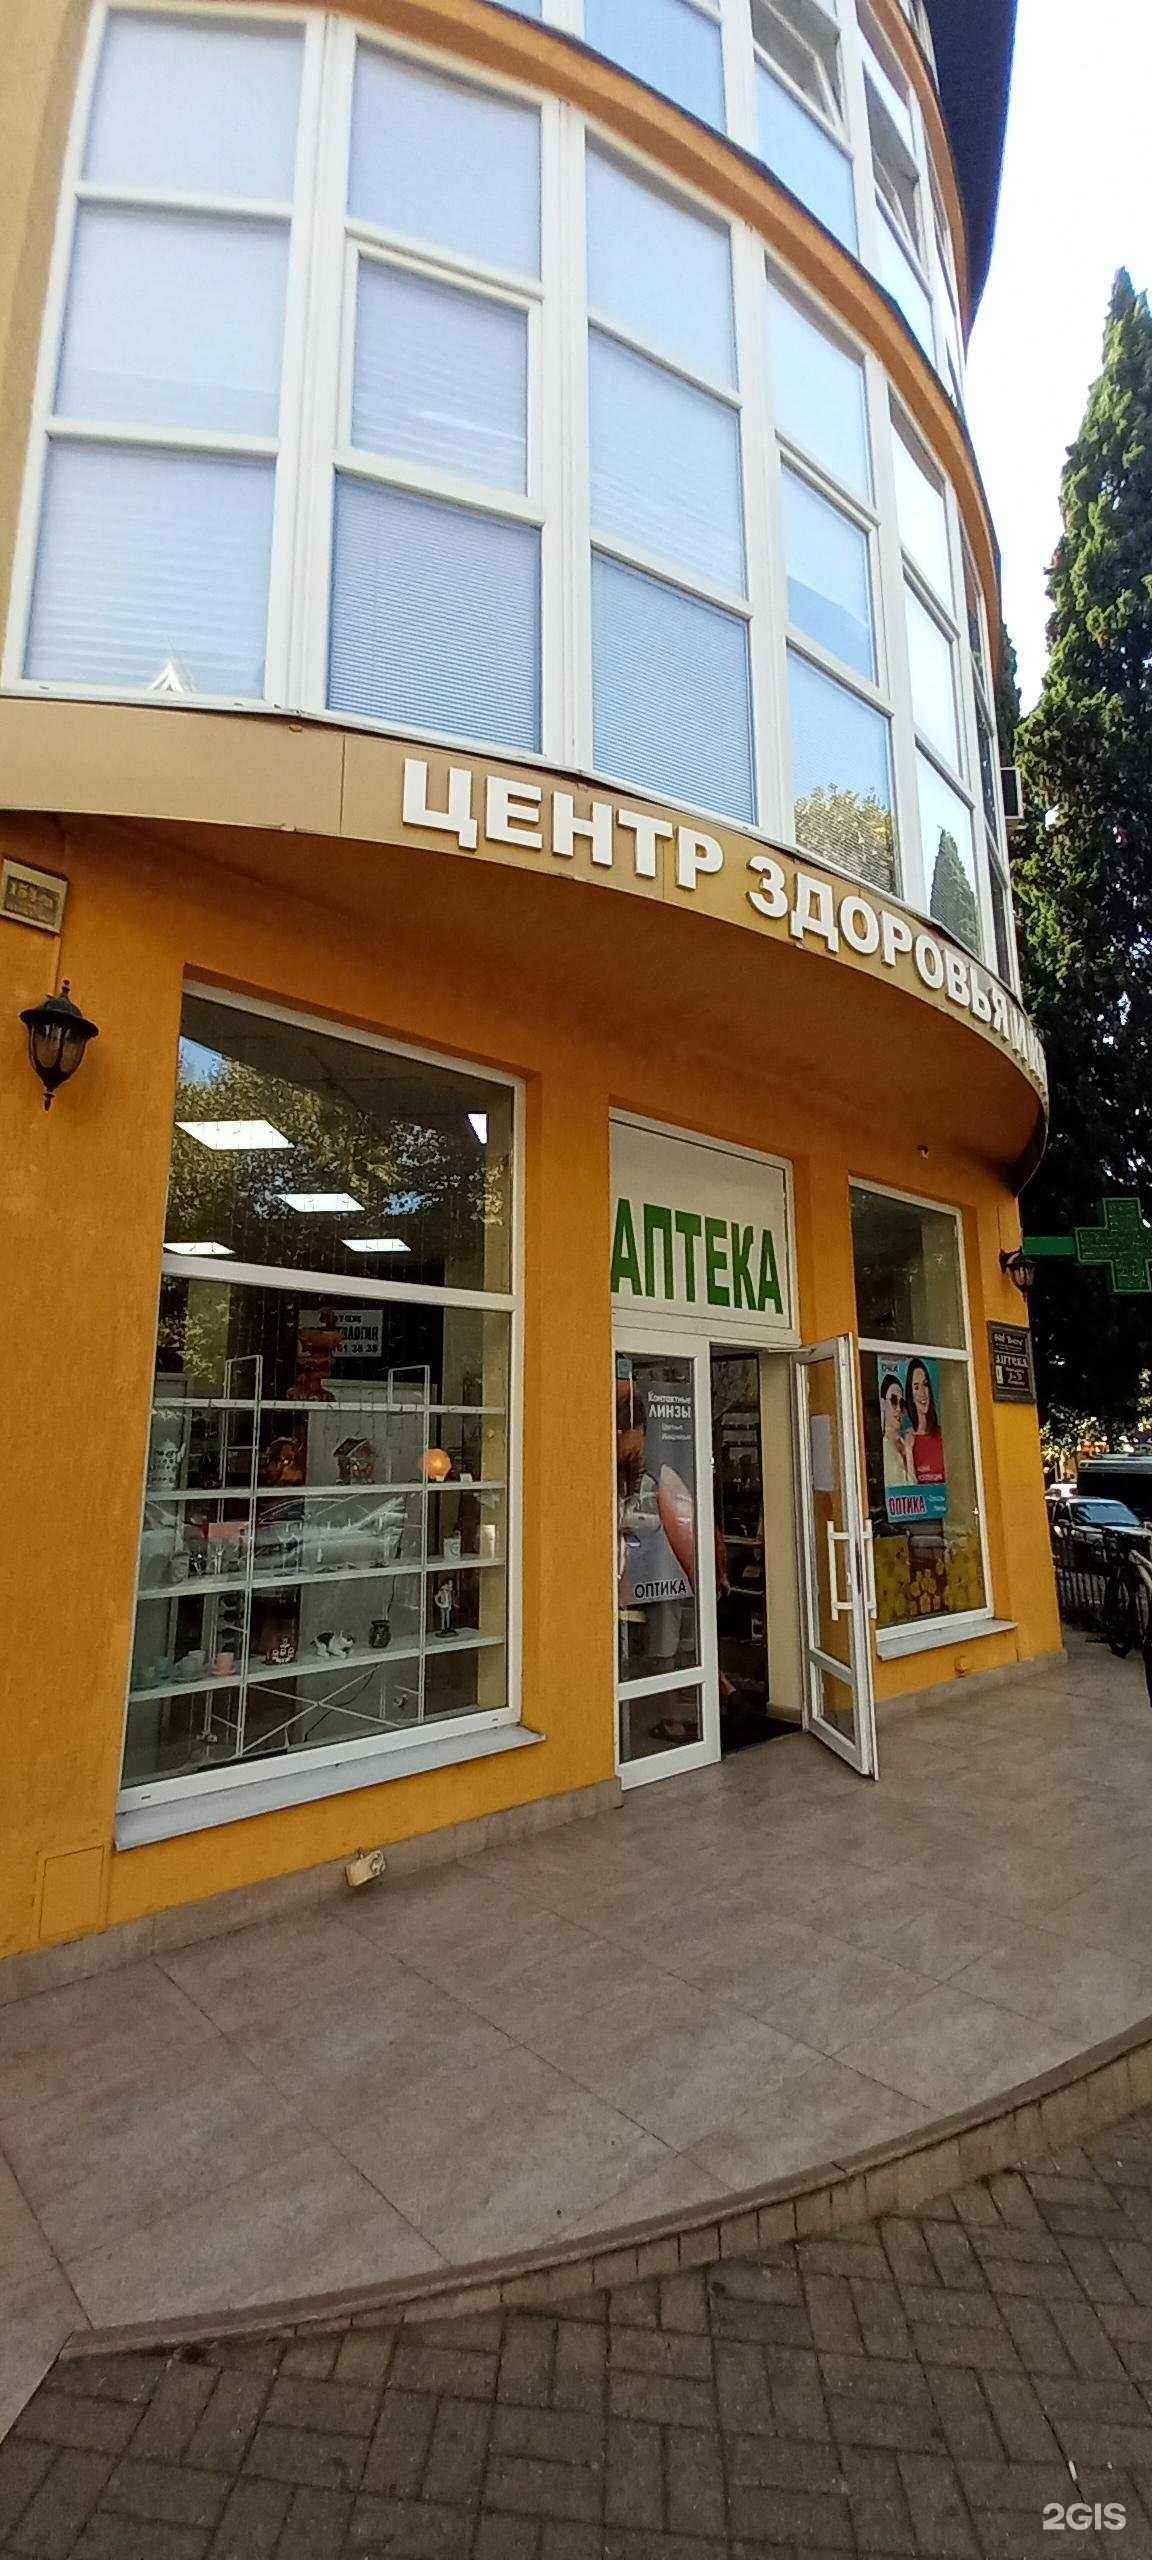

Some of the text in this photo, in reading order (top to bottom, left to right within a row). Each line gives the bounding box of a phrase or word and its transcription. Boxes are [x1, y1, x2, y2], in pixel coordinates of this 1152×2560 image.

[403, 758, 725, 890] ЦЕНТР
[747, 856, 1010, 1042] ЗДОРОВЬЯ
[610, 1197, 784, 1315] АПТЕКА
[649, 1404, 692, 1419] ЛИНЗЫ
[889, 1496, 926, 1515] ОПТИКА
[634, 1578, 688, 1599] ОПТИКА
